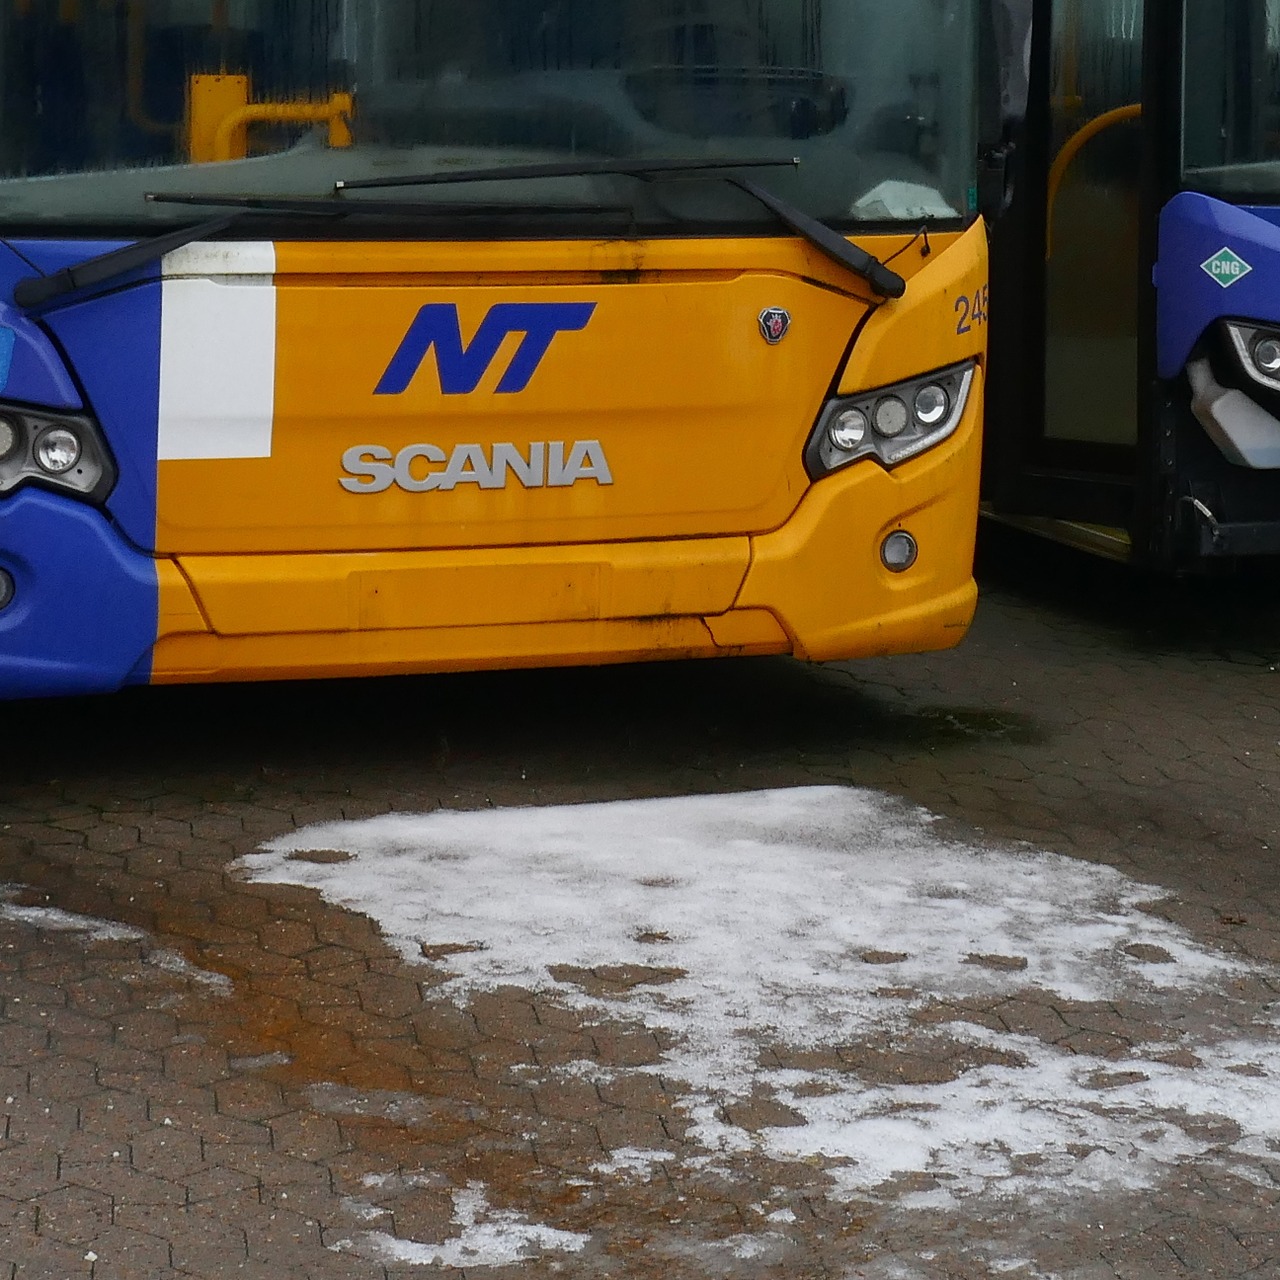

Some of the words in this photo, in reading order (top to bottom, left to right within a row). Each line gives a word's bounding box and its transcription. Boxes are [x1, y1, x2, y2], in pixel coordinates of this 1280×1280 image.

[1211, 260, 1240, 275] CNG
[372, 302, 598, 395] NT
[338, 440, 613, 493] SCANIA
